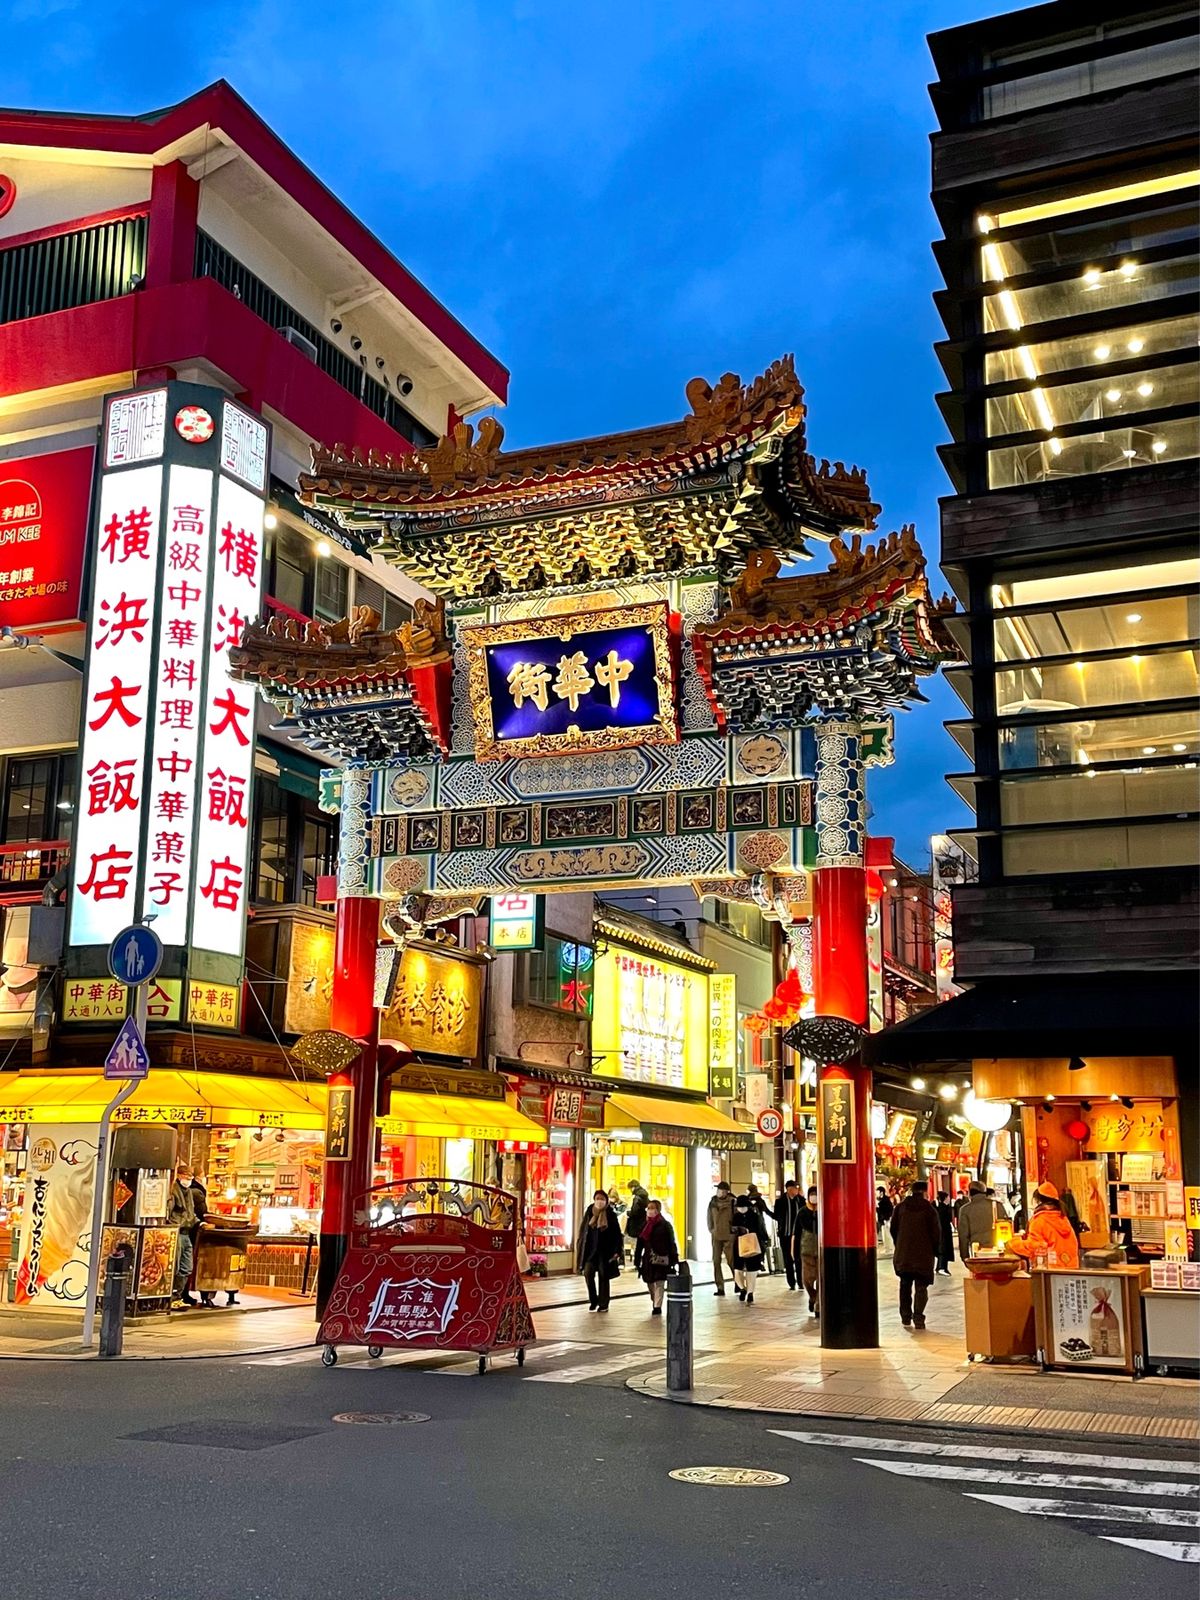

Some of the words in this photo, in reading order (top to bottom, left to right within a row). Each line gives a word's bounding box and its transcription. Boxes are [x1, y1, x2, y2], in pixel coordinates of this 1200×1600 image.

[18, 525, 41, 542] KEE
[506, 650, 635, 713] 中華街
[76, 506, 153, 903] 横浜大飯店
[498, 927, 528, 939] 本店
[70, 983, 126, 1002] 中華街
[190, 986, 235, 1011] 中華街
[68, 1005, 124, 1018] 大通り入口
[189, 1007, 234, 1023] 大通り入口
[114, 1107, 207, 1122] 横浜大飯店
[762, 1117, 778, 1130] 30
